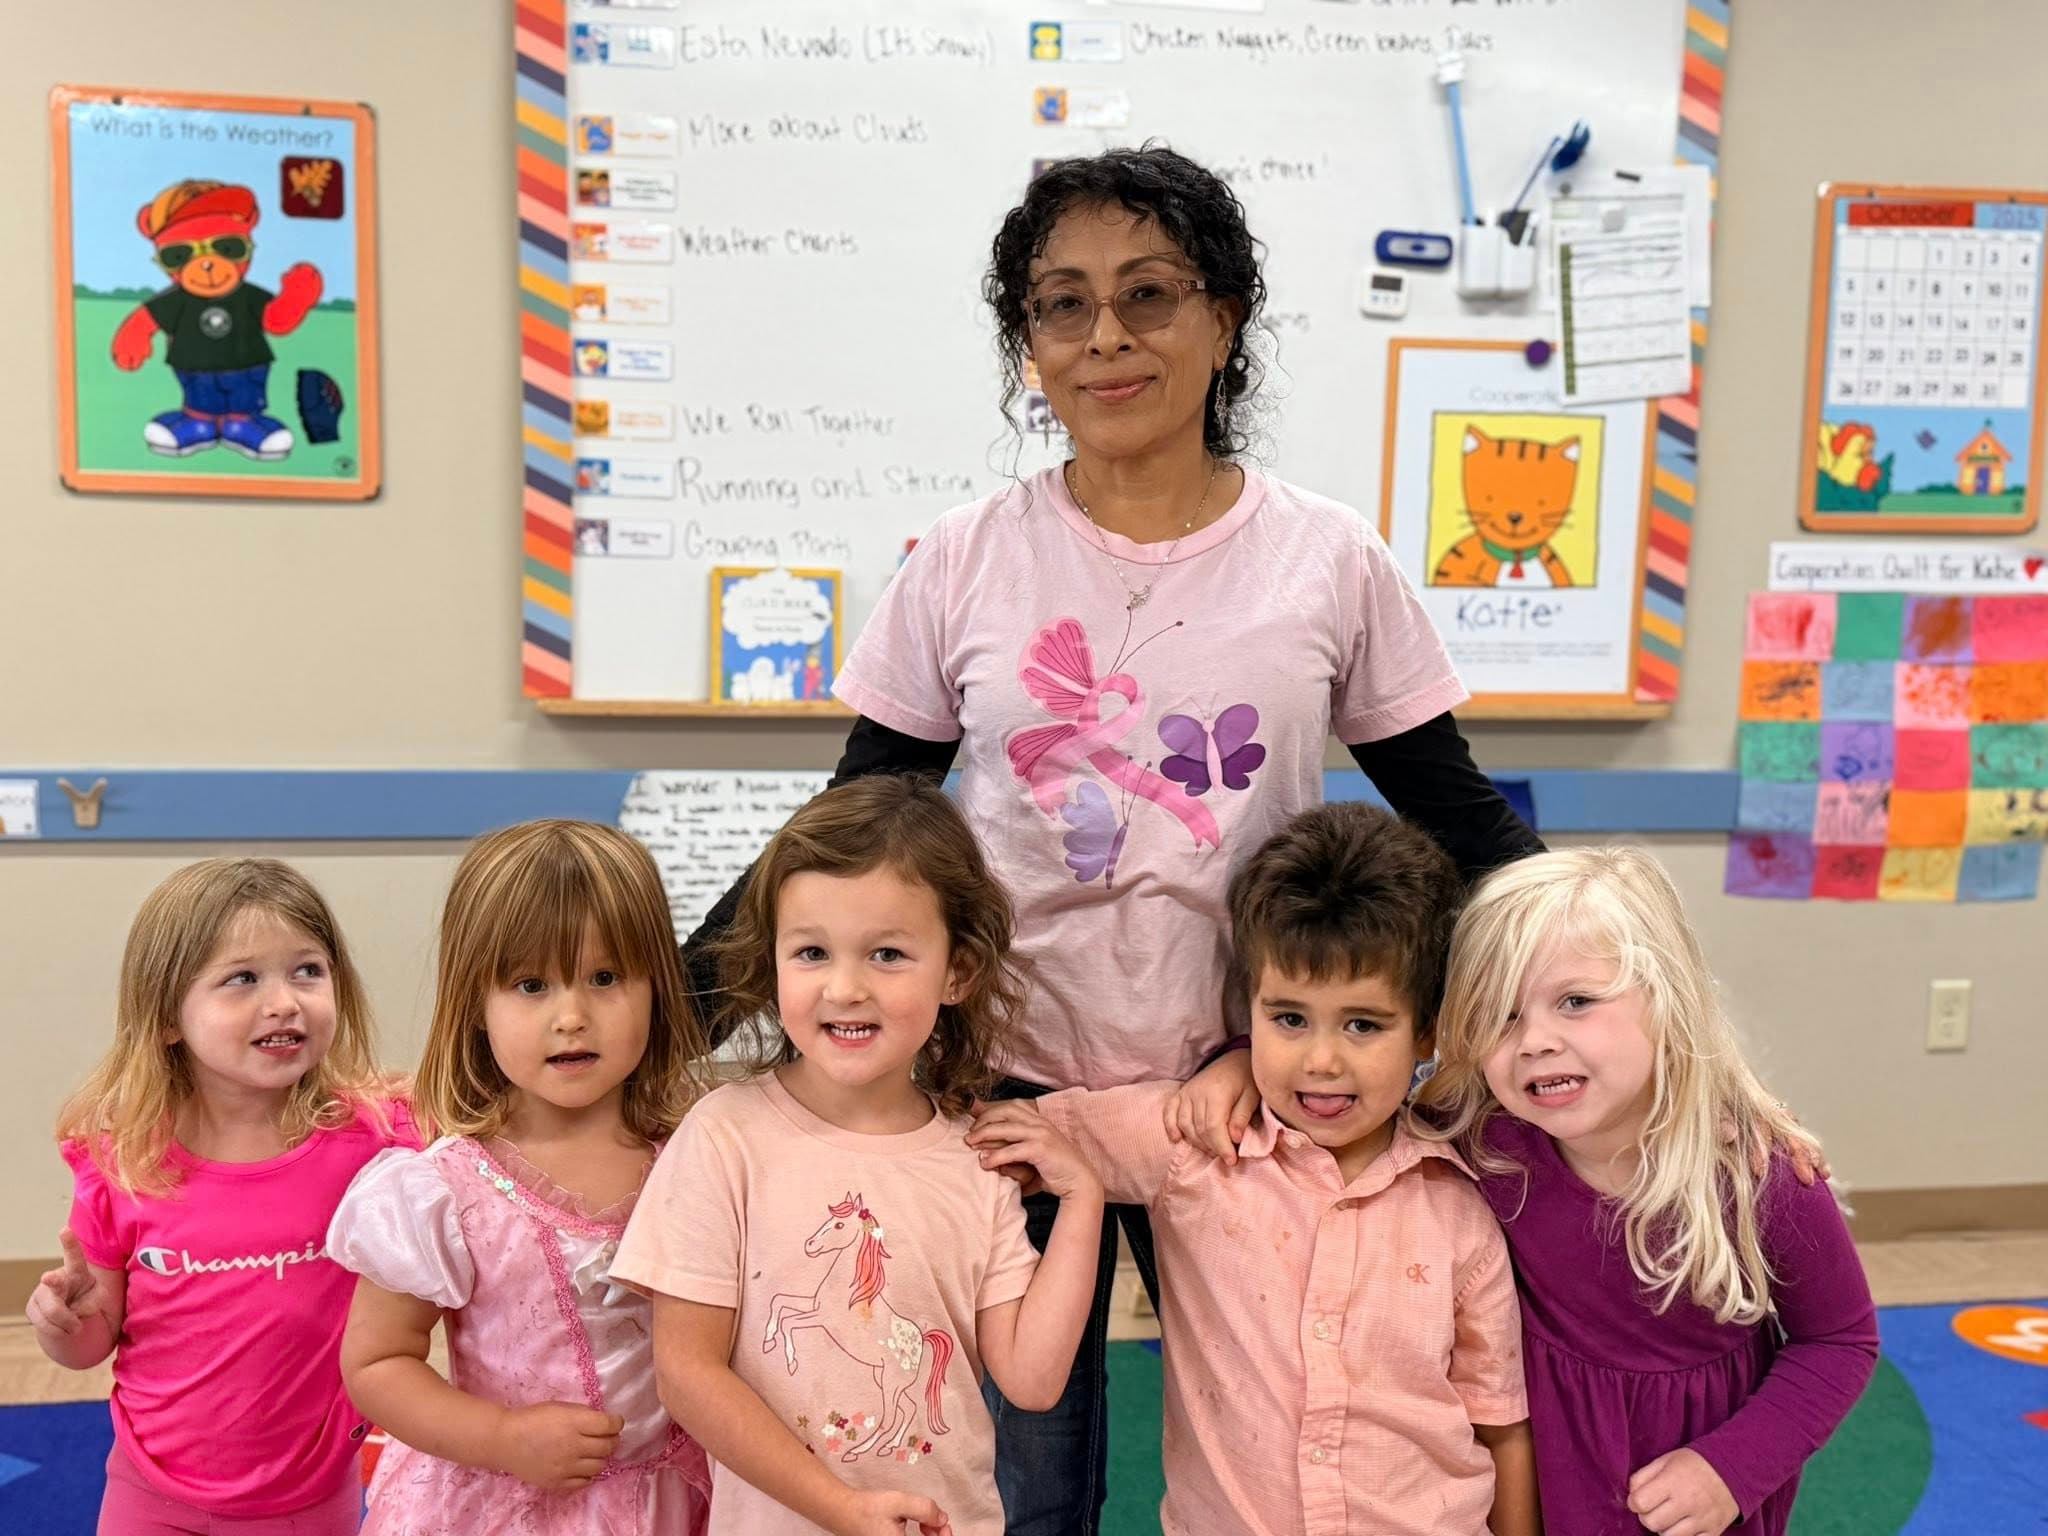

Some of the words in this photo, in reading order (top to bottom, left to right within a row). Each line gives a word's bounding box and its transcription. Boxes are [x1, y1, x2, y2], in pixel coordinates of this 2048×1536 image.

[93, 115, 152, 138] What
[159, 117, 173, 140] is
[181, 121, 218, 142] the
[226, 123, 333, 148] Weather?
[688, 113, 755, 148] More
[768, 113, 841, 141] about
[1867, 205, 1956, 223] October
[678, 225, 777, 257] Weather
[683, 405, 732, 436] We
[800, 404, 897, 448] Together
[678, 456, 801, 509] Running
[810, 466, 872, 500] and
[1777, 553, 1873, 591] Cooperation
[1883, 553, 1929, 580] Quilt
[1940, 554, 1961, 580] for
[1973, 555, 2016, 580] Katie
[1456, 594, 1552, 632] Katie
